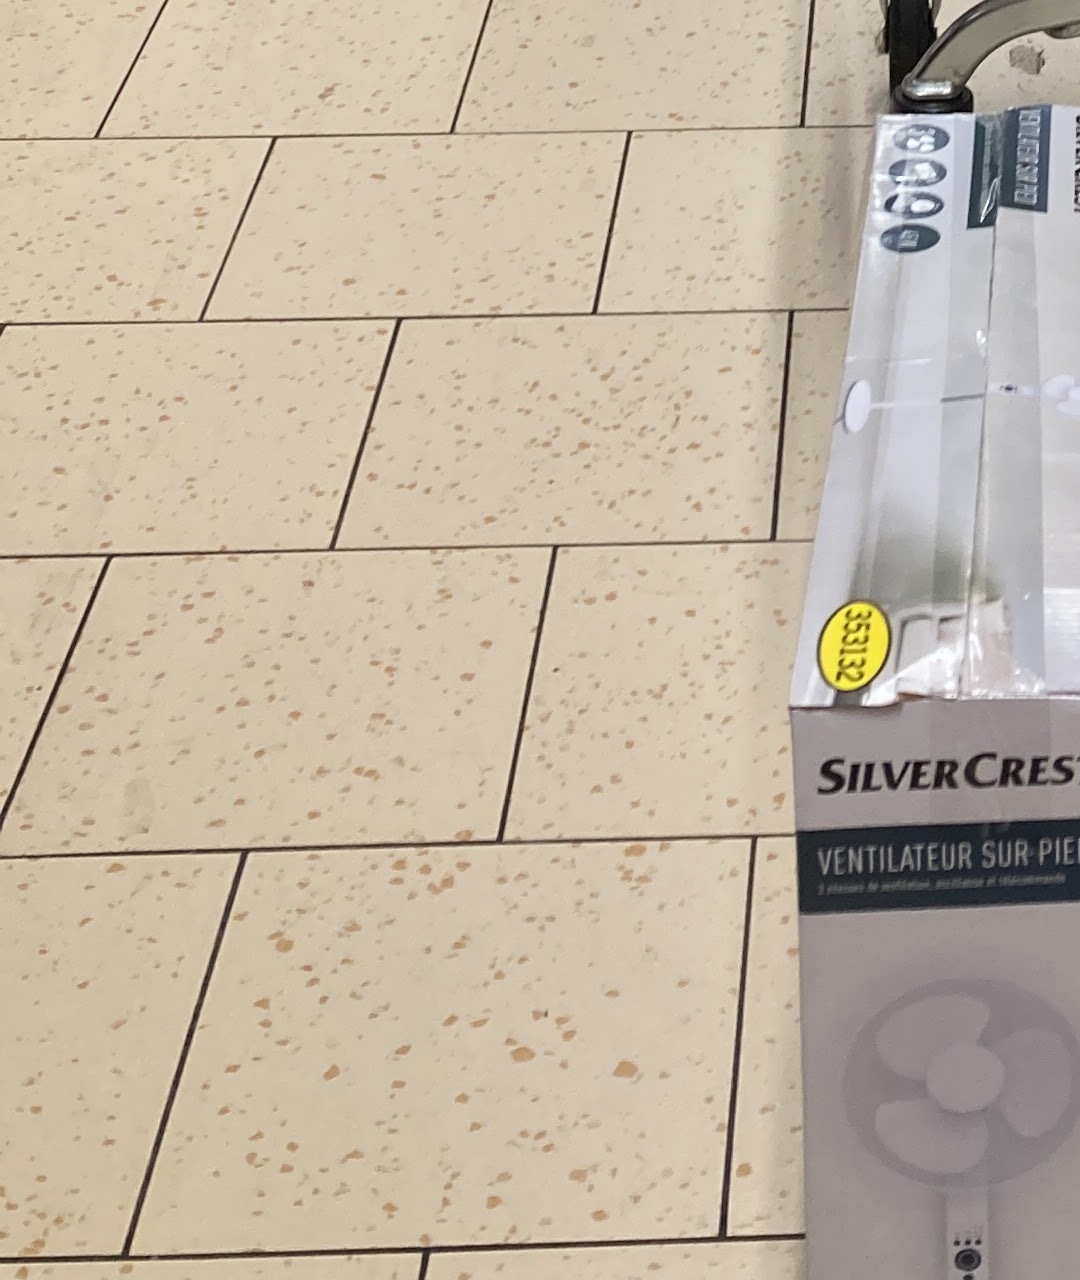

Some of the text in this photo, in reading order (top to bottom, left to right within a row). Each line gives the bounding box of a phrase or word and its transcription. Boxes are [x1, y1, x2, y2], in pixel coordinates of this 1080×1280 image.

[835, 608, 873, 682] 353132
[816, 838, 973, 878] VENTILATEUR
[981, 836, 1029, 871] SUR
